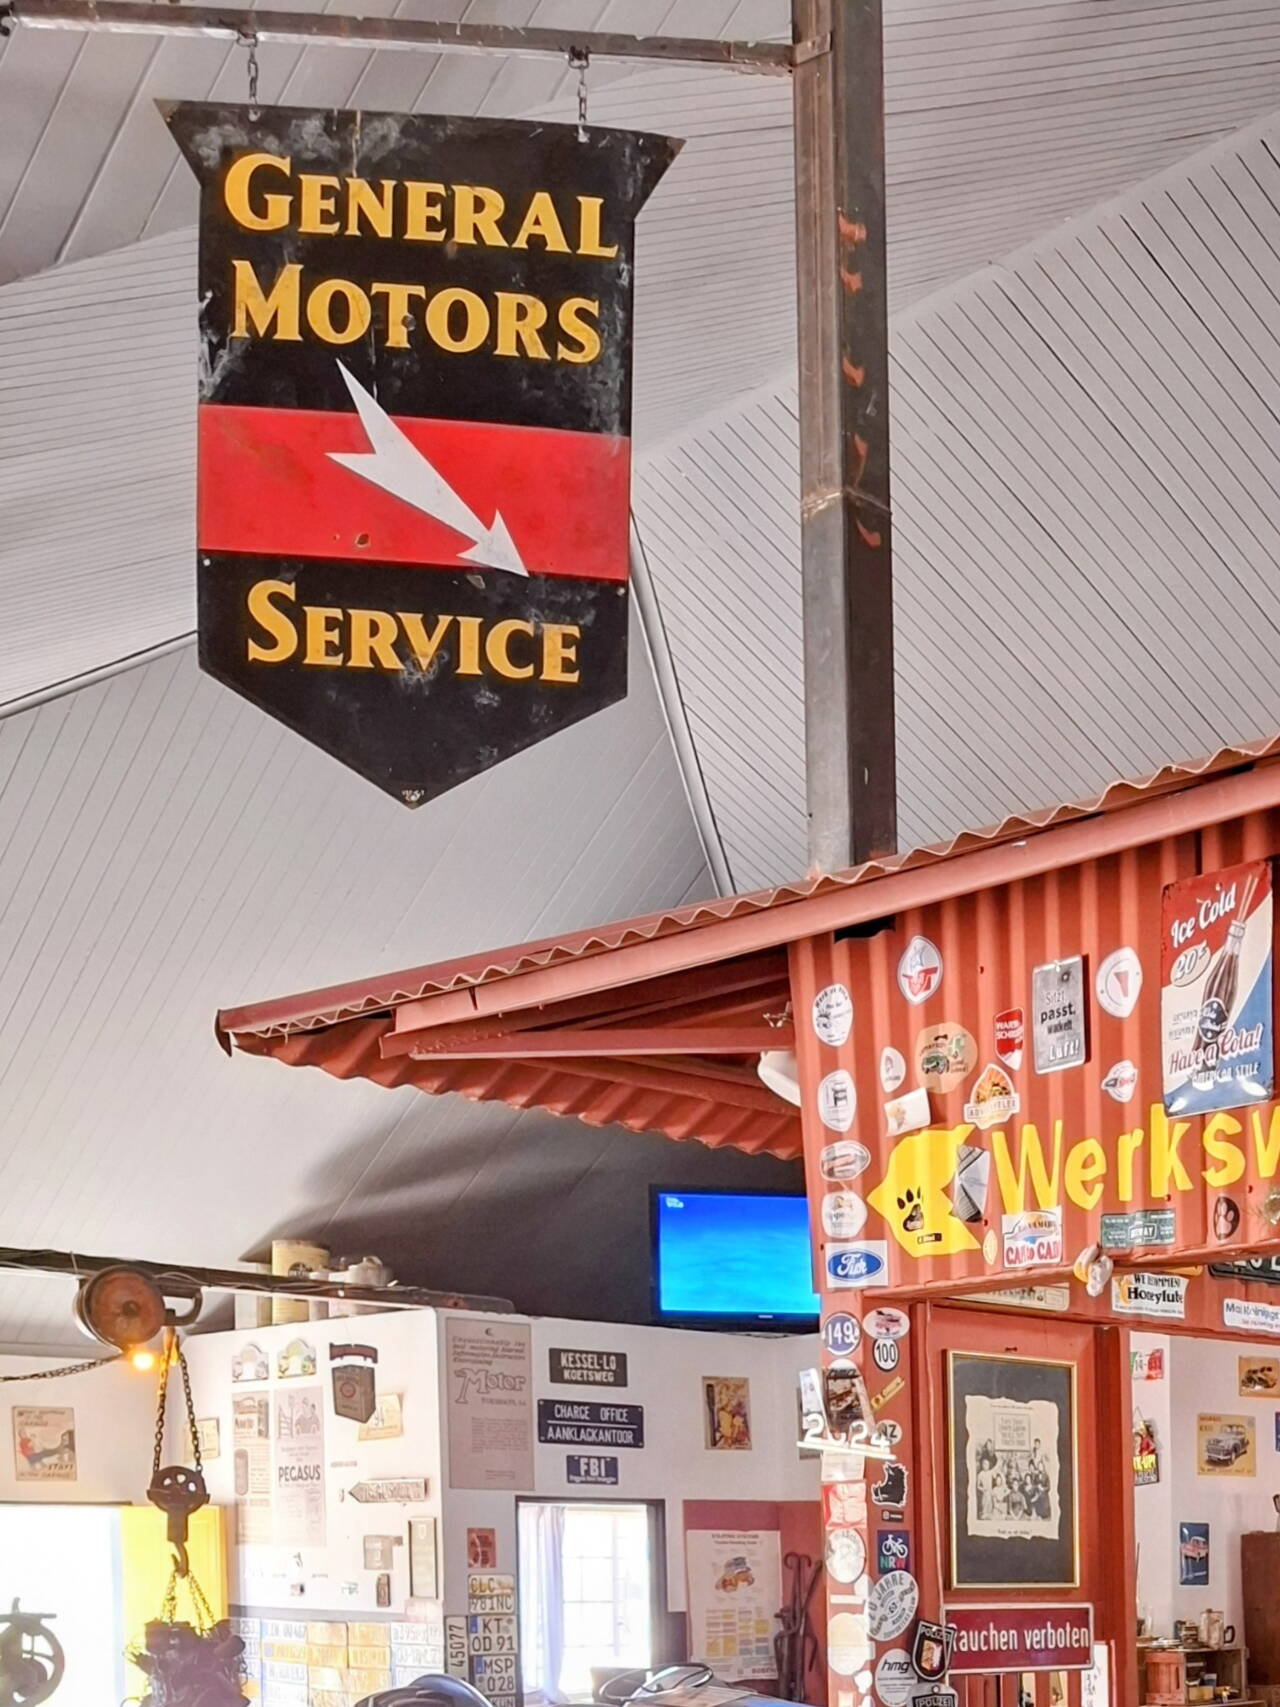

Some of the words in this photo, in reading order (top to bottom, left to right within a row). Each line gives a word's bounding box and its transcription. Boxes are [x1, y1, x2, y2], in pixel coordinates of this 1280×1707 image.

[224, 152, 619, 260] GENERAL
[231, 259, 601, 364] MOTORS
[247, 579, 581, 683] SERVICE
[1171, 918, 1196, 948] Ice
[1200, 882, 1236, 930] Cold
[1040, 1002, 1077, 1025] passt.
[1049, 1038, 1080, 1062] Luft!
[1168, 1050, 1203, 1076] Have
[1219, 1022, 1263, 1059] Cola!
[1235, 1061, 1261, 1079] STYLE
[828, 1321, 856, 1345] 149
[560, 1351, 616, 1370] KESSEL-LO
[876, 1343, 897, 1363] 100
[563, 1369, 615, 1383] KOETSWEG
[554, 1404, 590, 1420] CHARGE
[600, 1408, 629, 1422] OFFICE
[547, 1425, 634, 1444] AANKLAGKANTOOR
[278, 1464, 321, 1483] PEGASUS
[579, 1457, 606, 1477] FBI
[482, 1618, 502, 1634] KT
[1024, 1621, 1090, 1649] verboten
[448, 1623, 466, 1668] 45077
[471, 1635, 492, 1652] OD
[496, 1635, 515, 1651] 91
[484, 1658, 514, 1674] MSP
